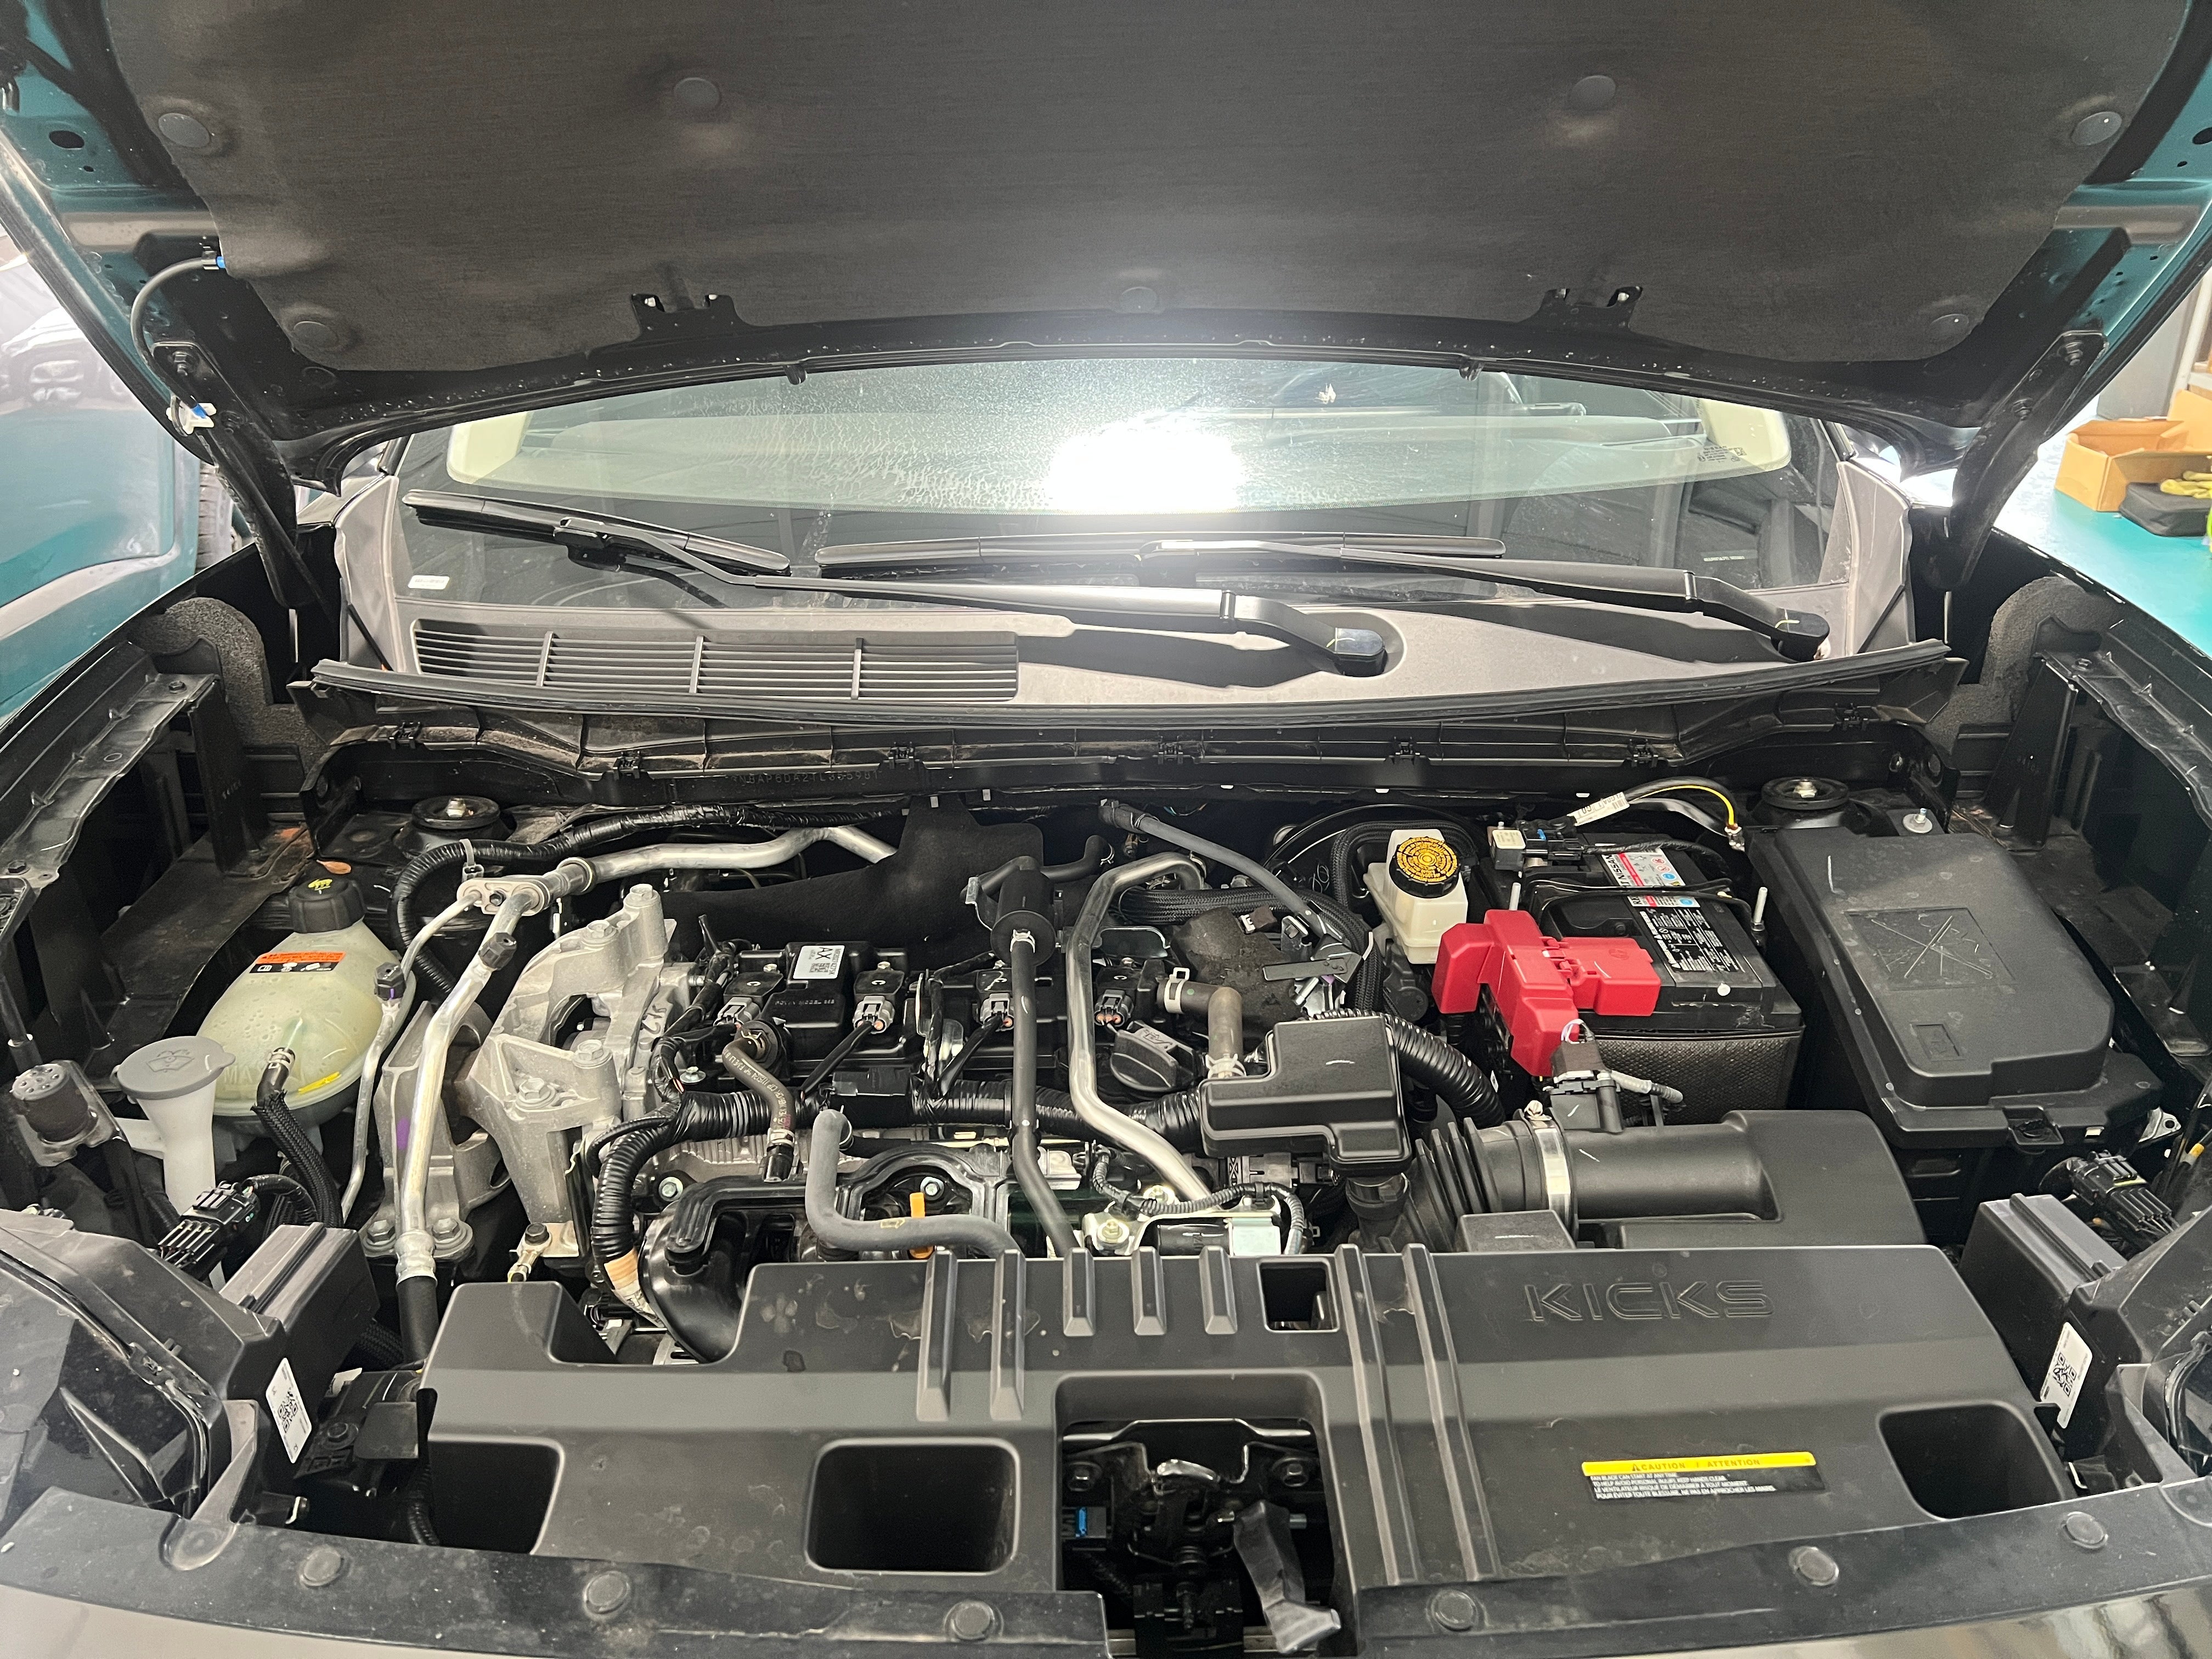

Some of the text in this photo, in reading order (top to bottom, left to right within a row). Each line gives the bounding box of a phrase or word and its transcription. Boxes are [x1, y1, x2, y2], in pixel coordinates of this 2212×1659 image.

[815, 947, 833, 960] AX
[1525, 1280, 1775, 1322] KICKS
[1641, 1462, 1685, 1471] CAUTION
